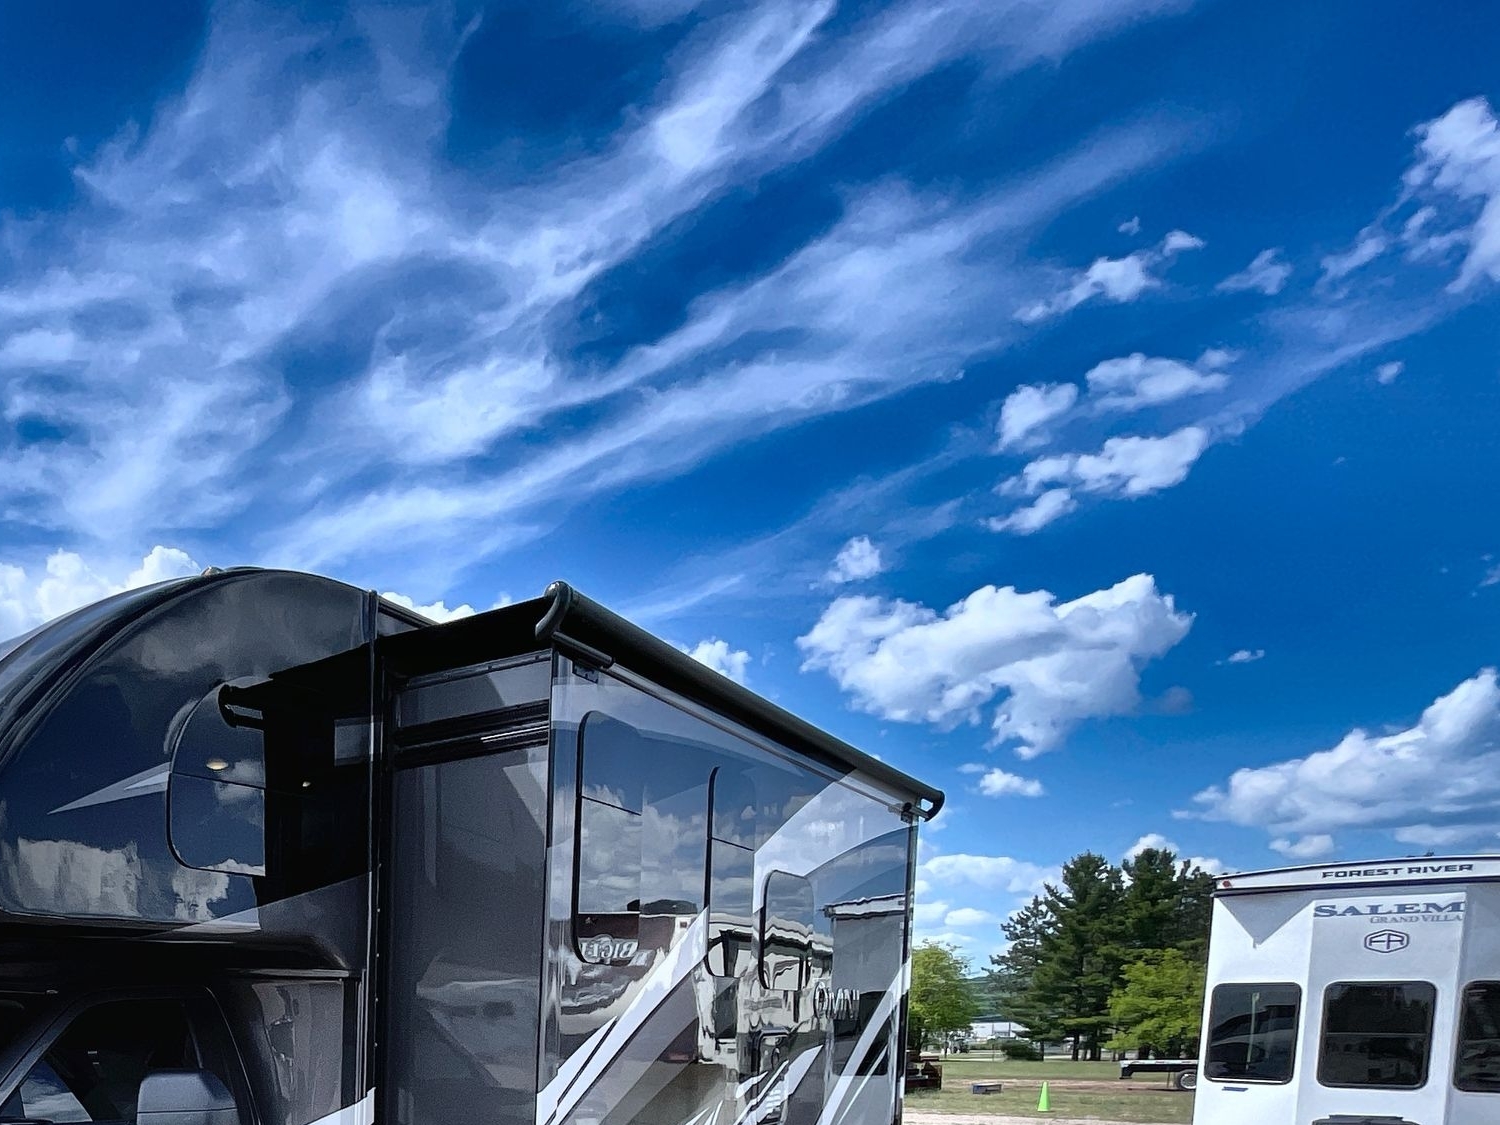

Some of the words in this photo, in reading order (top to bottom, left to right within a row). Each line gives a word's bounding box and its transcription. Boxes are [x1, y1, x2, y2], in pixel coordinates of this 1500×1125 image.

[1322, 867, 1403, 879] FOREST
[1408, 863, 1474, 875] RIVER
[1313, 901, 1465, 918] SALEM
[1370, 915, 1419, 924] GRAND
[1422, 914, 1463, 923] VILLA
